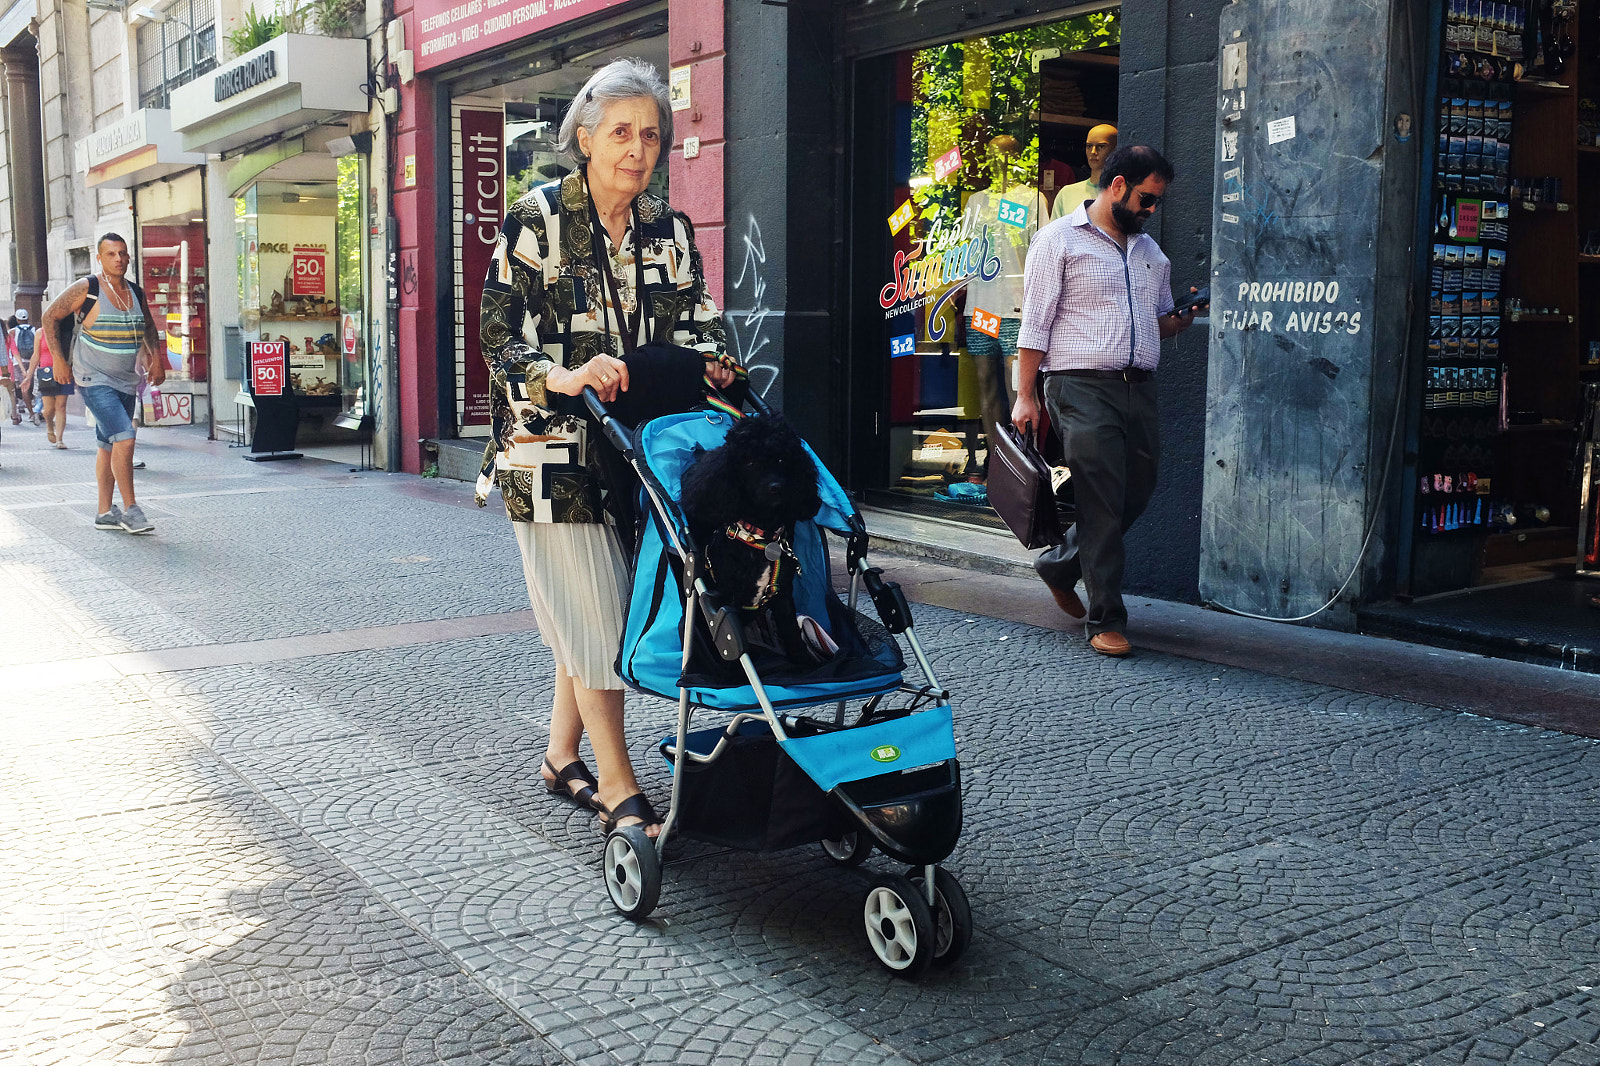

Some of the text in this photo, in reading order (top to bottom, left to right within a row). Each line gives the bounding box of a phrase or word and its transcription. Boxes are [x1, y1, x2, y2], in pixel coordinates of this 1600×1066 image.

[450, 0, 483, 22] CELULARES
[421, 32, 458, 57] INFORMÁTICA
[461, 24, 479, 43] VIDEO
[483, 11, 512, 36] CUIDADO
[512, 0, 548, 26] PERSONAL
[214, 49, 277, 102] MARCEL RONEL
[934, 151, 959, 176] 3x2
[464, 132, 499, 245] circuit
[890, 204, 912, 231] 3x2
[1000, 202, 1026, 224] 3x2
[880, 223, 1001, 312] Summer
[1238, 281, 1340, 304] PROHIBIDO
[885, 294, 936, 320] NEW COLLECTION
[973, 311, 998, 334] 3x2
[1222, 310, 1362, 335] FIJAR AVISOS
[253, 343, 282, 354] HOY
[892, 336, 914, 356] 3x2
